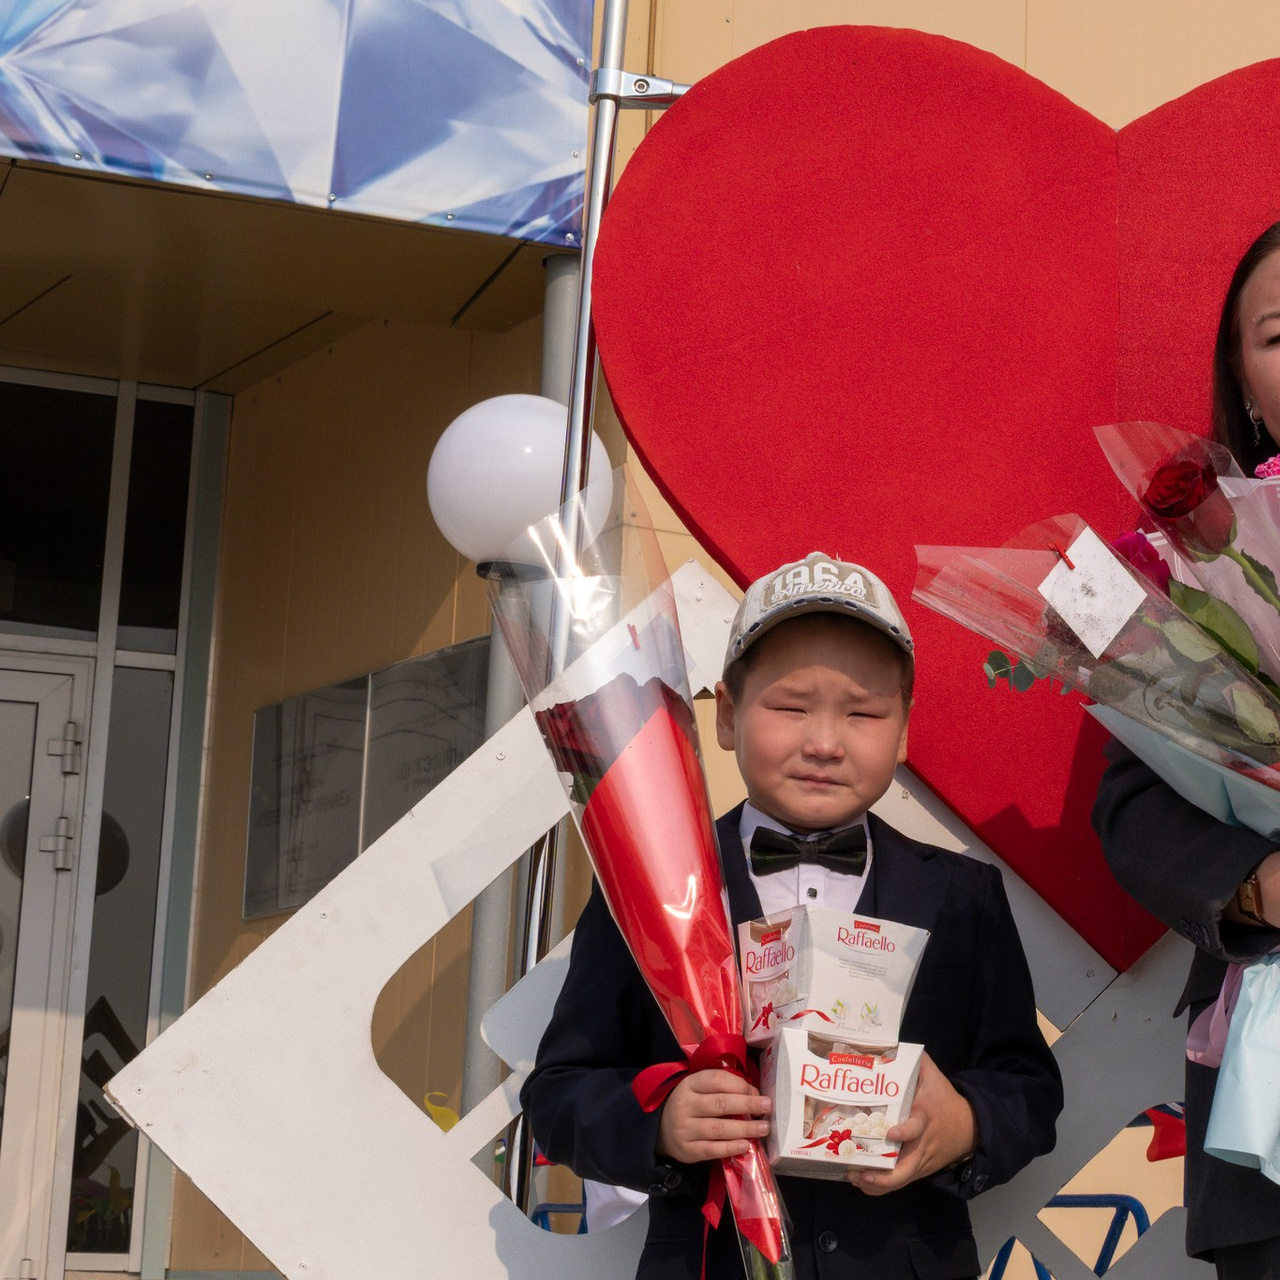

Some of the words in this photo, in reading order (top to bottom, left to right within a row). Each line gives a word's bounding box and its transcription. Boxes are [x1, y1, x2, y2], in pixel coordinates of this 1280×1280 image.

[771, 580, 867, 600] America
[837, 926, 895, 952] Raffaello
[745, 945, 795, 974] Raffaello
[831, 1055, 872, 1067] Confetteria
[800, 1063, 899, 1097] Raffaello
